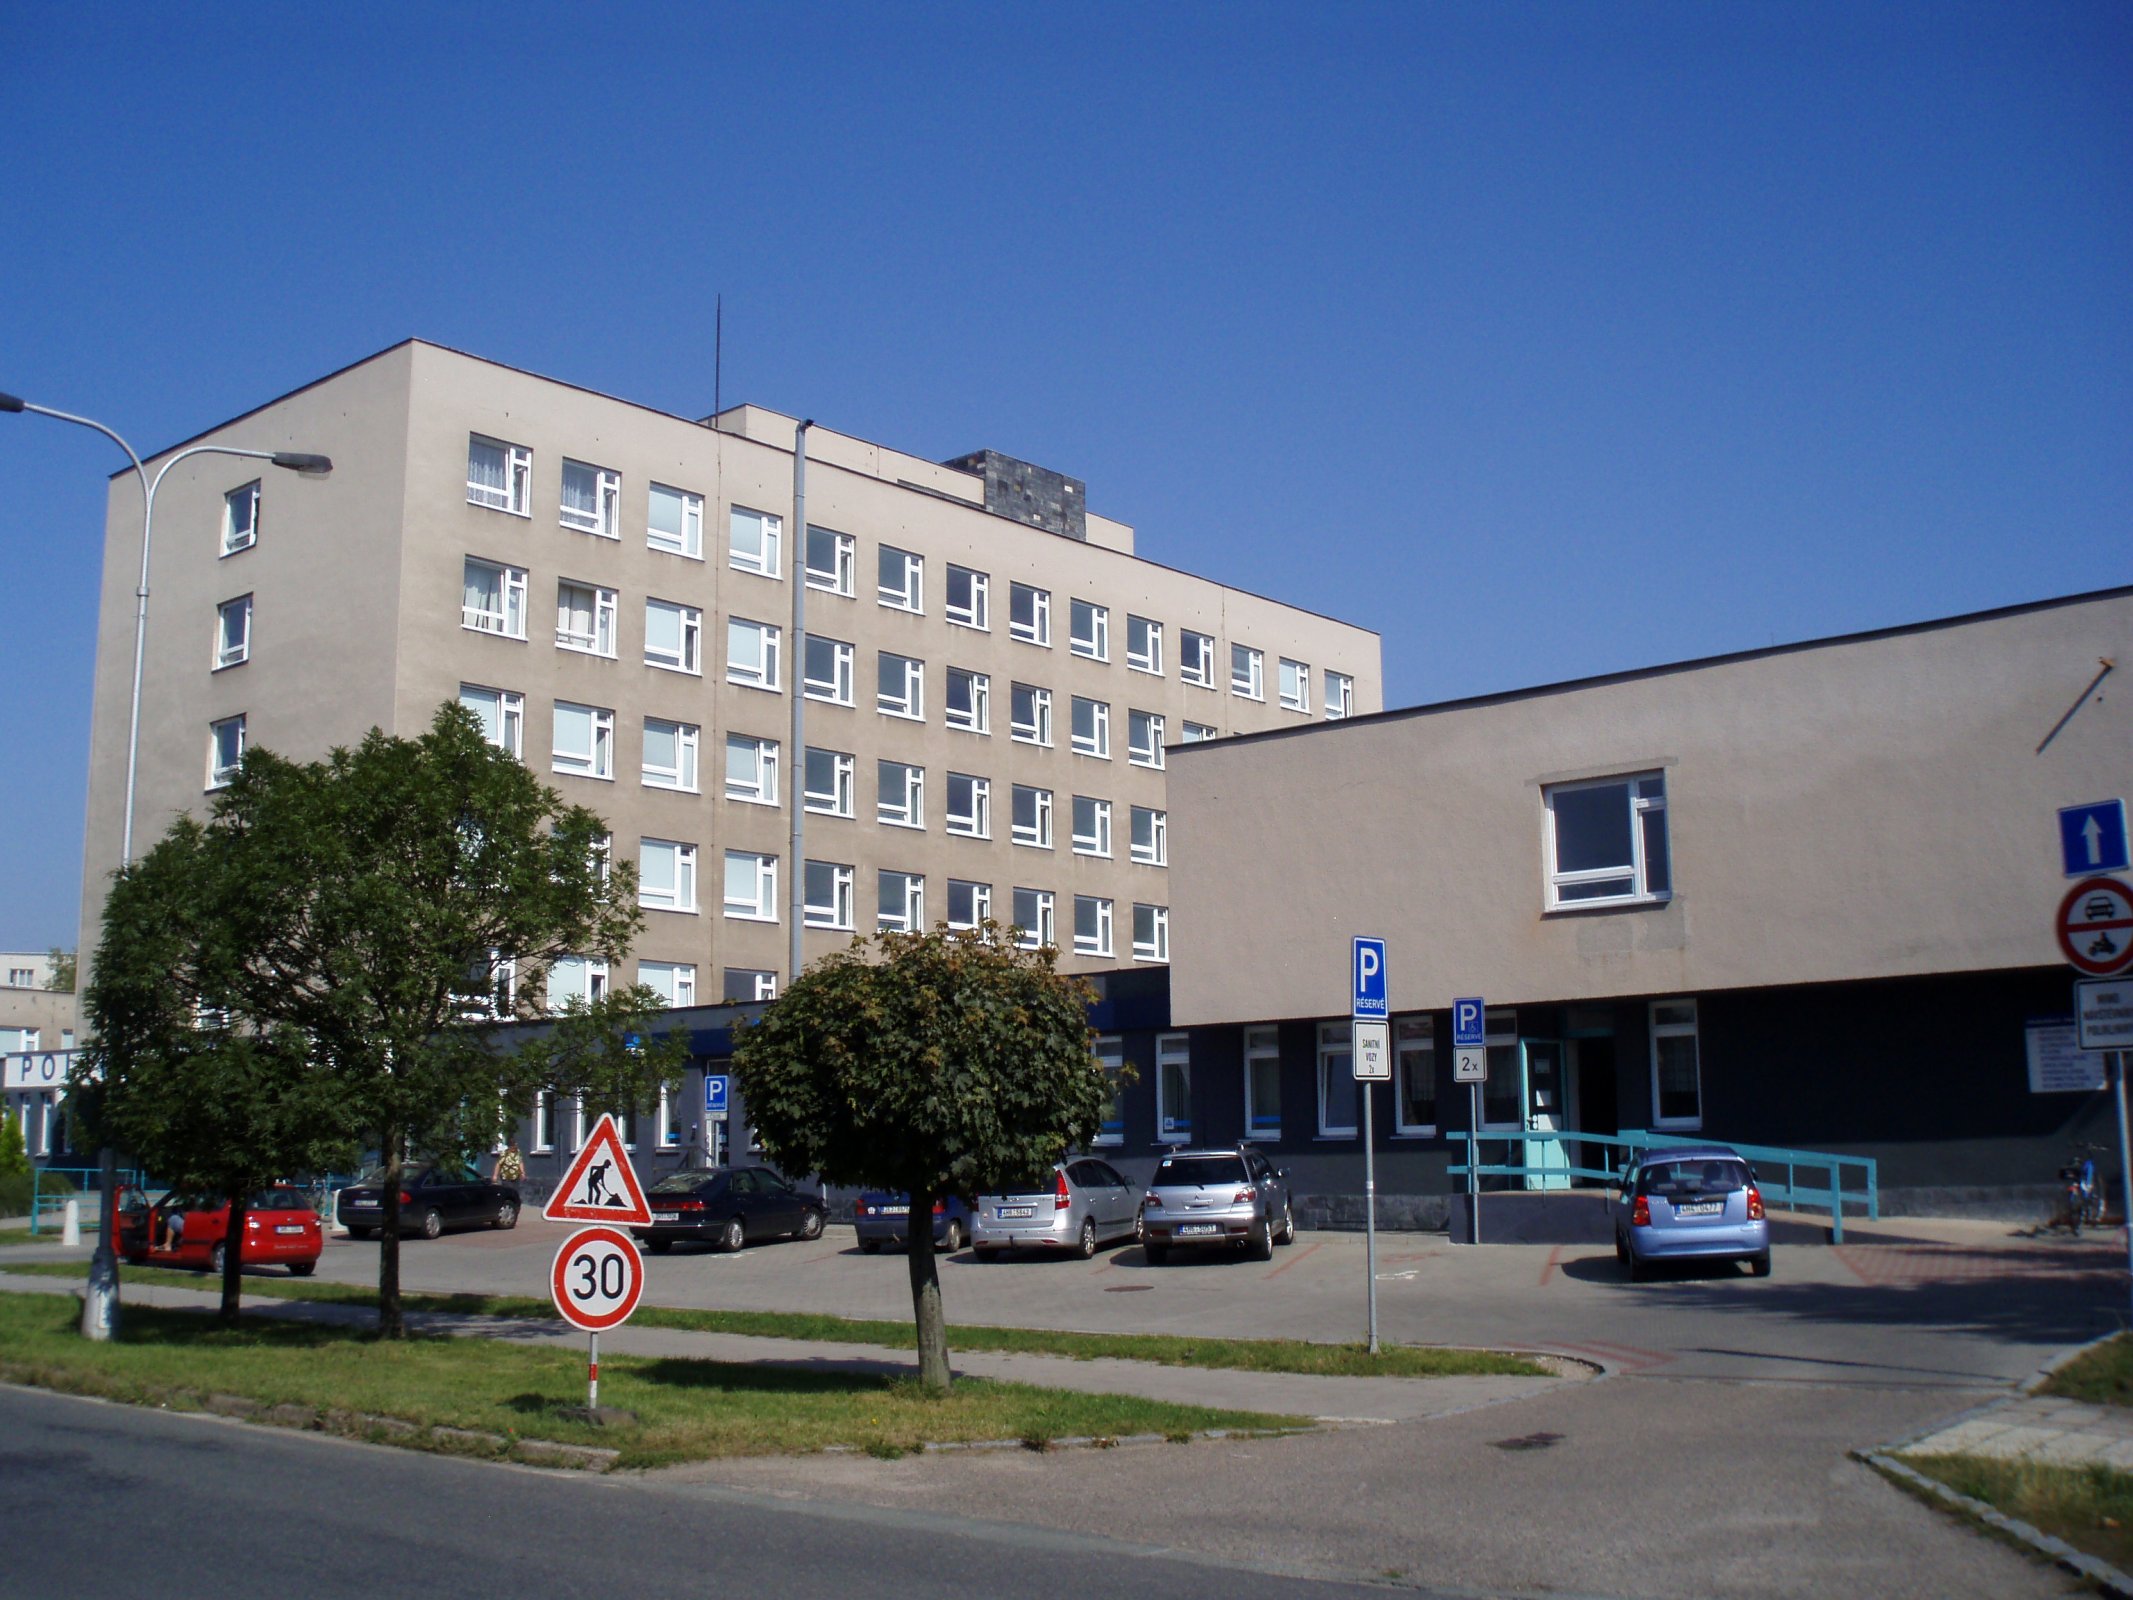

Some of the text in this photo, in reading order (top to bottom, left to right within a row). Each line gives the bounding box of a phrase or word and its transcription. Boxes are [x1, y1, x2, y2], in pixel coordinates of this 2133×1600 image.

[1360, 947, 1379, 993] P
[1356, 996, 1385, 1009] RÉSERVÉ
[1460, 1003, 1477, 1031] P
[709, 1080, 723, 1101] P
[573, 1253, 624, 1300] 30
